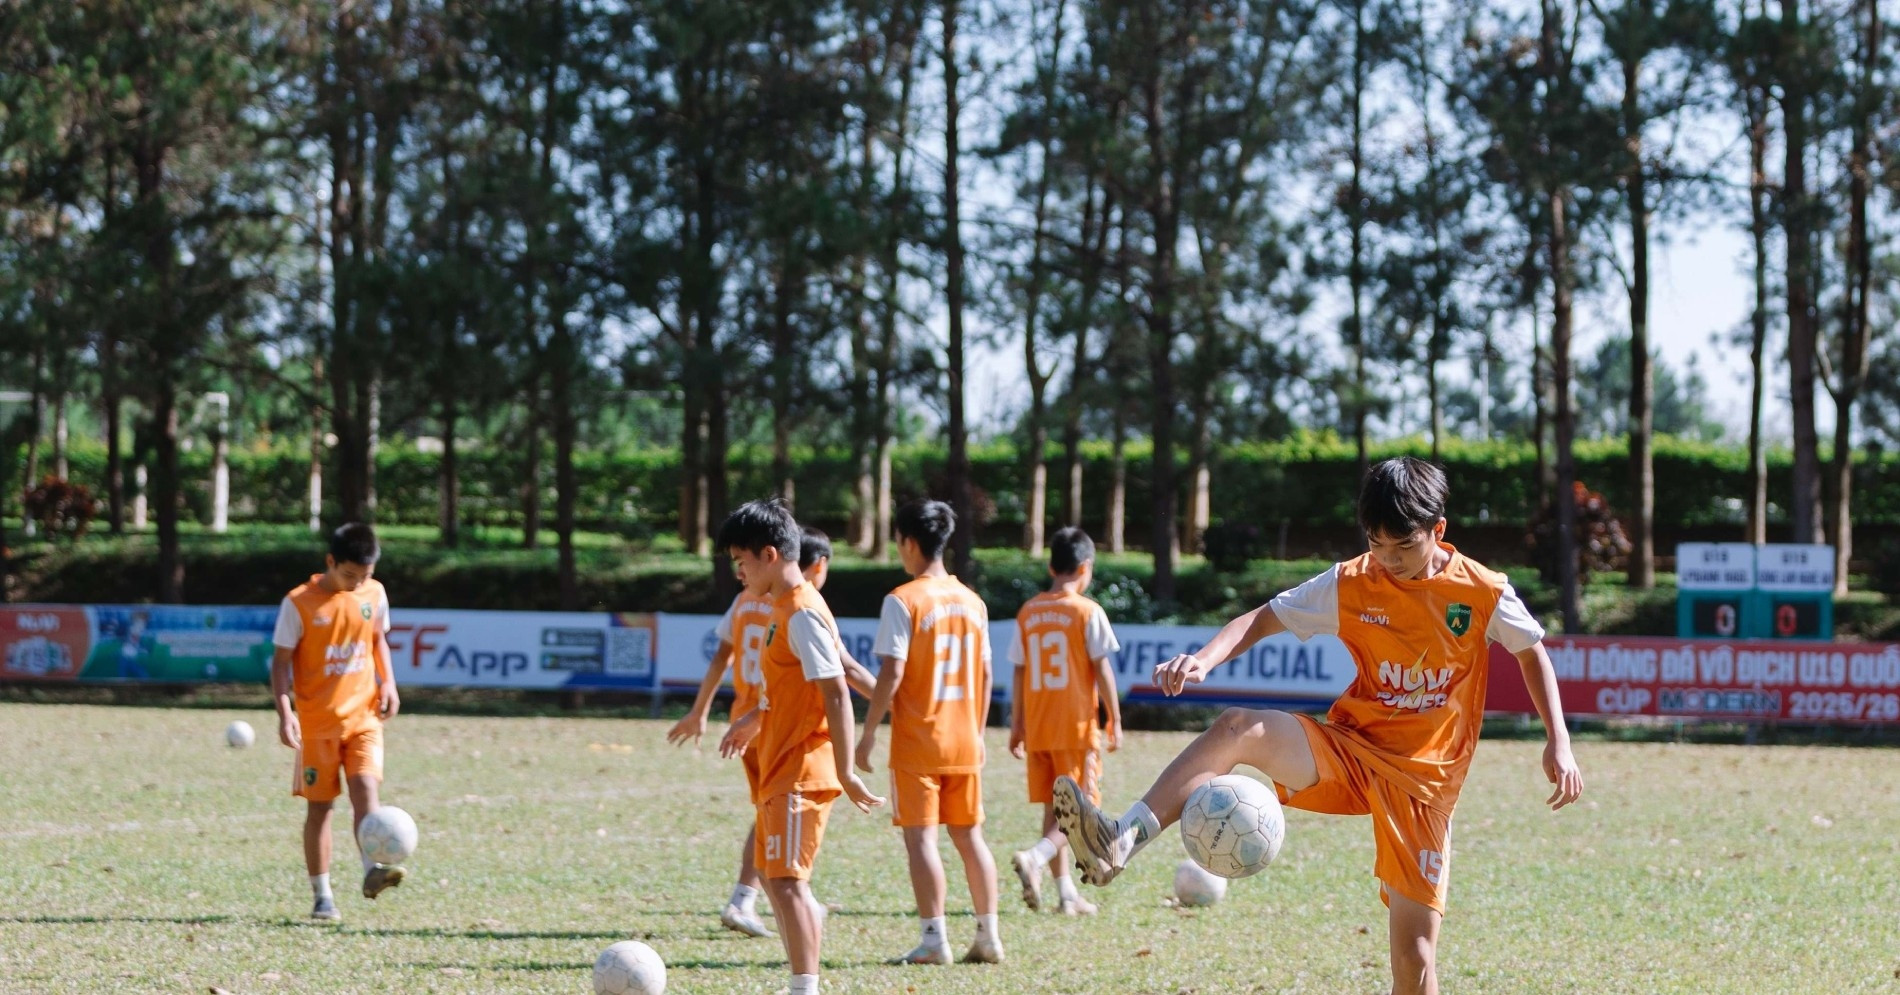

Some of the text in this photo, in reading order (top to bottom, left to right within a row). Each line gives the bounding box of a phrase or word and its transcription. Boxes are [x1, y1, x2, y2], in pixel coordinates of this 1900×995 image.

[1716, 604, 1736, 635] 0
[1777, 604, 1797, 636] 0
[386, 625, 448, 667] FF
[1028, 630, 1069, 692] 13
[1546, 640, 1586, 681] IẢI
[1799, 651, 1847, 687] U19
[933, 633, 975, 701] 21
[1658, 687, 1782, 715] MODERN
[1789, 691, 1899, 720] 2025/26
[766, 834, 781, 860] 21
[1419, 849, 1443, 884] 15
